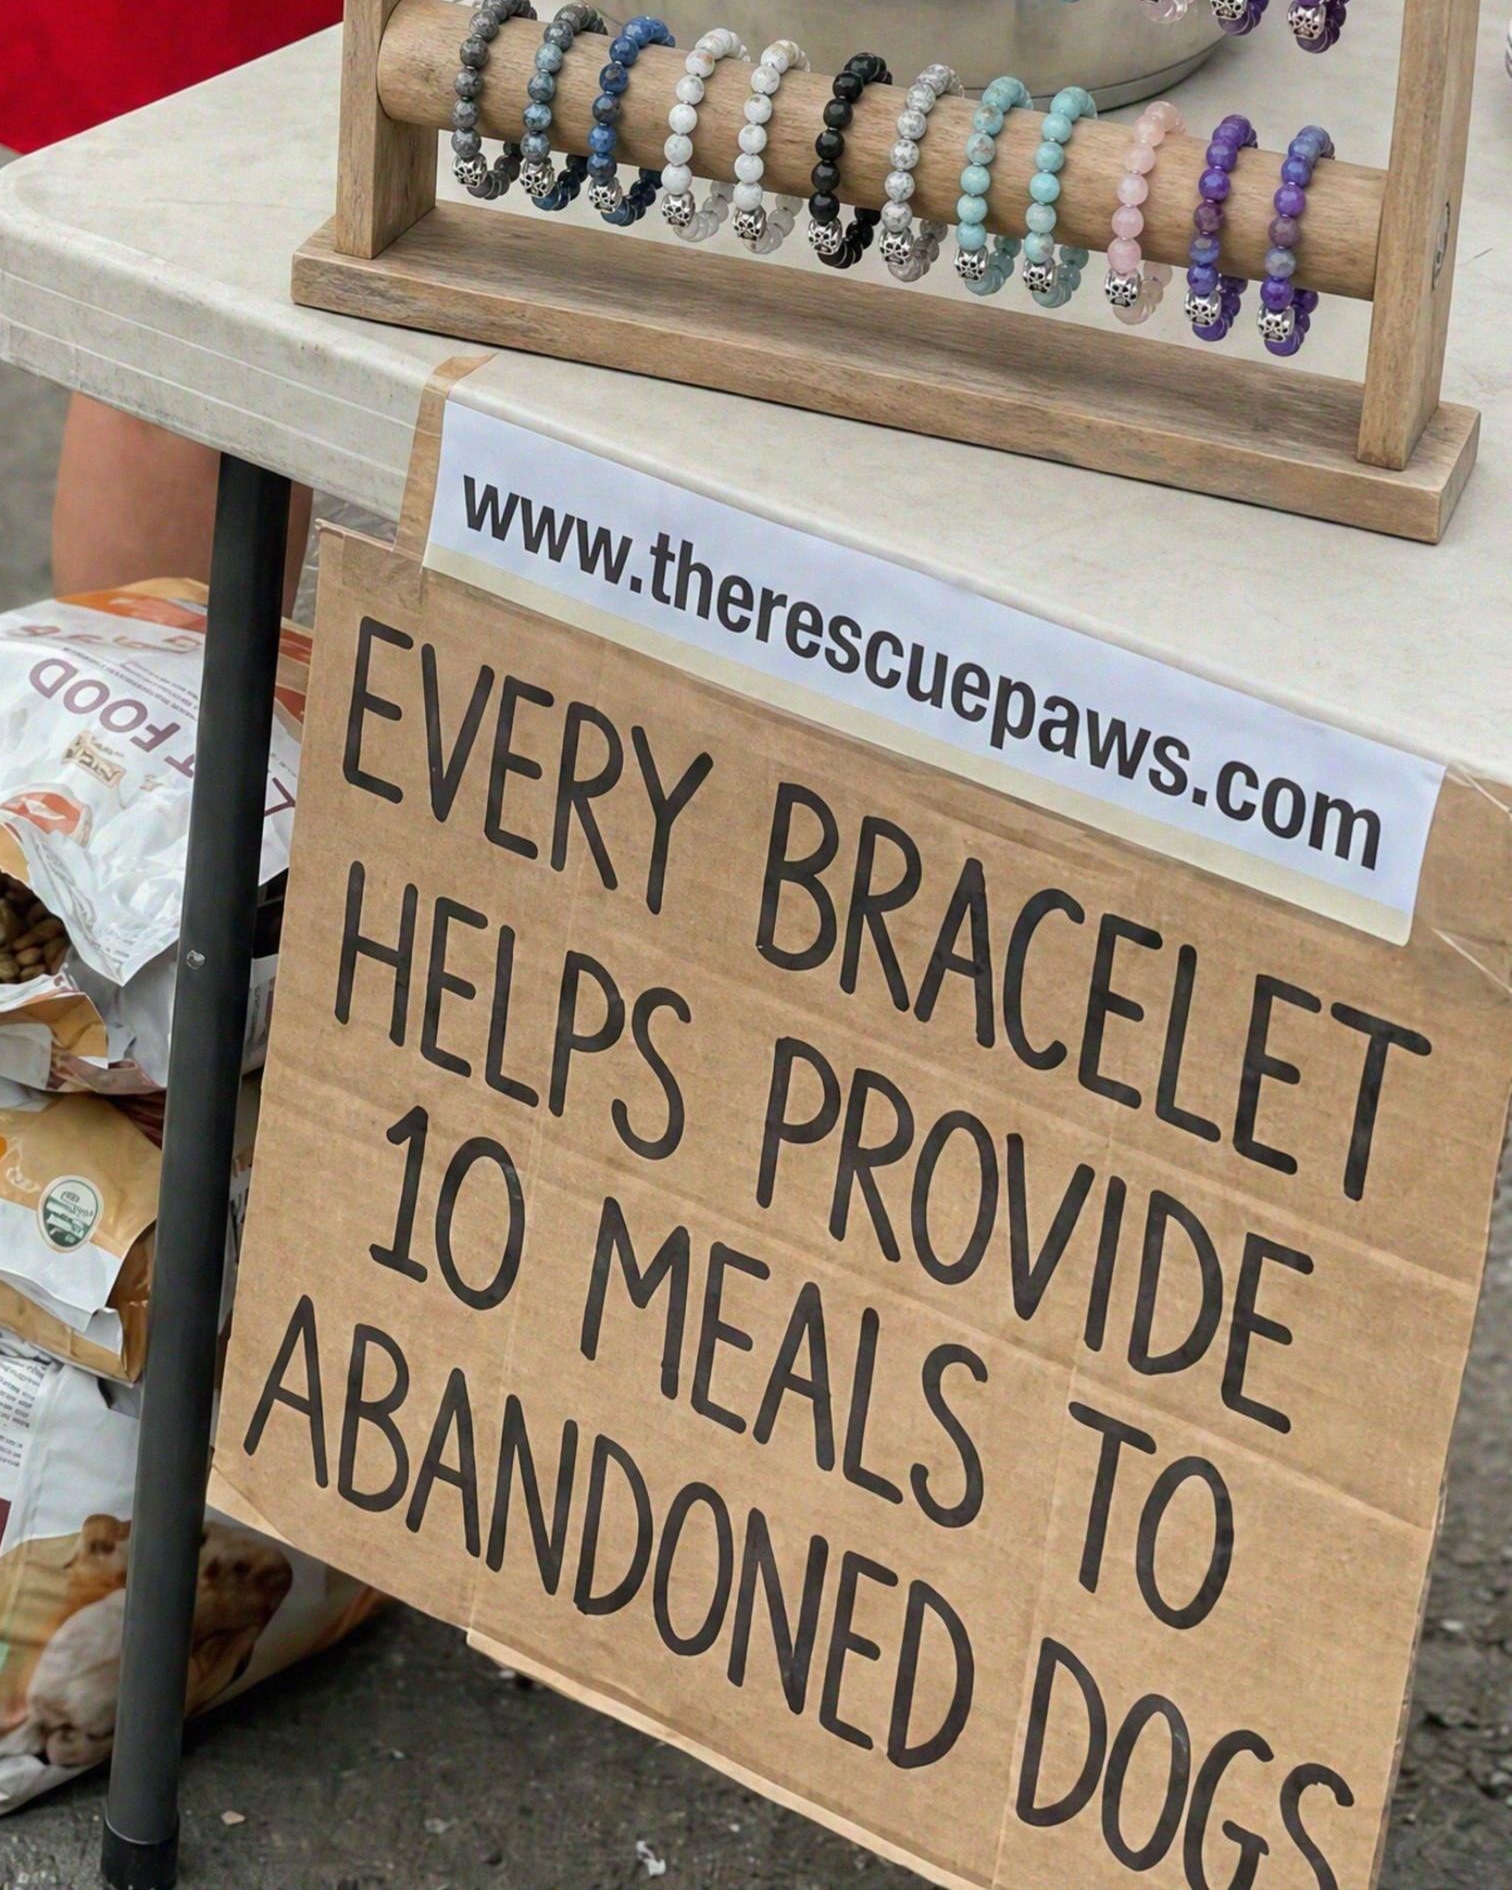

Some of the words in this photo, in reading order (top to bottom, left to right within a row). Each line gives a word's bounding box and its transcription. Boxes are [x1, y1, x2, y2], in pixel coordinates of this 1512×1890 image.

[30, 657, 181, 754] FOOD
[341, 615, 715, 917] EVERY
[754, 780, 1434, 1203] BRACELET
[461, 474, 1382, 871] www.therescuepaws.com
[333, 859, 693, 1161] HELPS
[755, 1035, 1315, 1435] PROVIDE
[367, 1104, 526, 1312] 10
[579, 1195, 989, 1529] MEALS
[1067, 1400, 1236, 1631] TO
[242, 1293, 976, 1771] ABANDONED
[1014, 1636, 1356, 1890] DOGS
